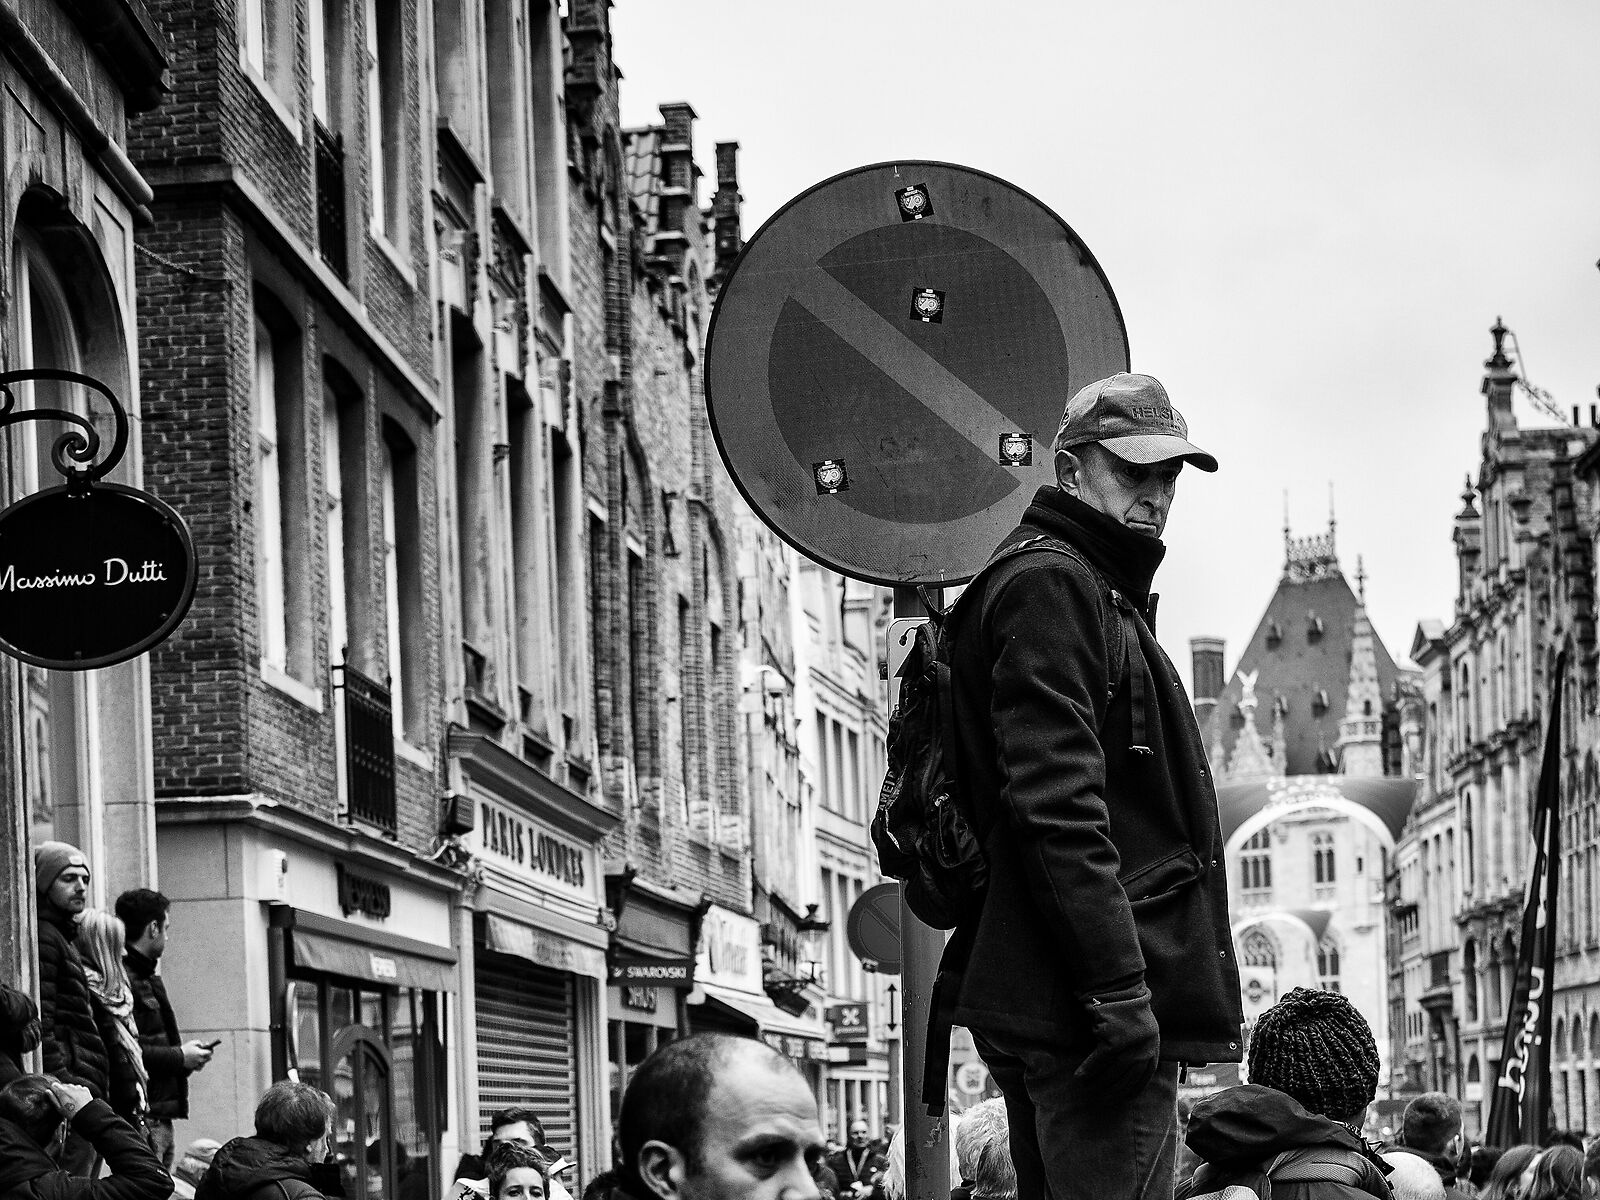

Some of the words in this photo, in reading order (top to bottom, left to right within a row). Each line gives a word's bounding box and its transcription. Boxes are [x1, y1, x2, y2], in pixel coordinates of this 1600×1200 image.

[103, 557, 168, 586] Dutti
[481, 802, 524, 866] PARIS
[528, 827, 585, 888] LONDRES
[626, 966, 687, 979] SWAROVSKI
